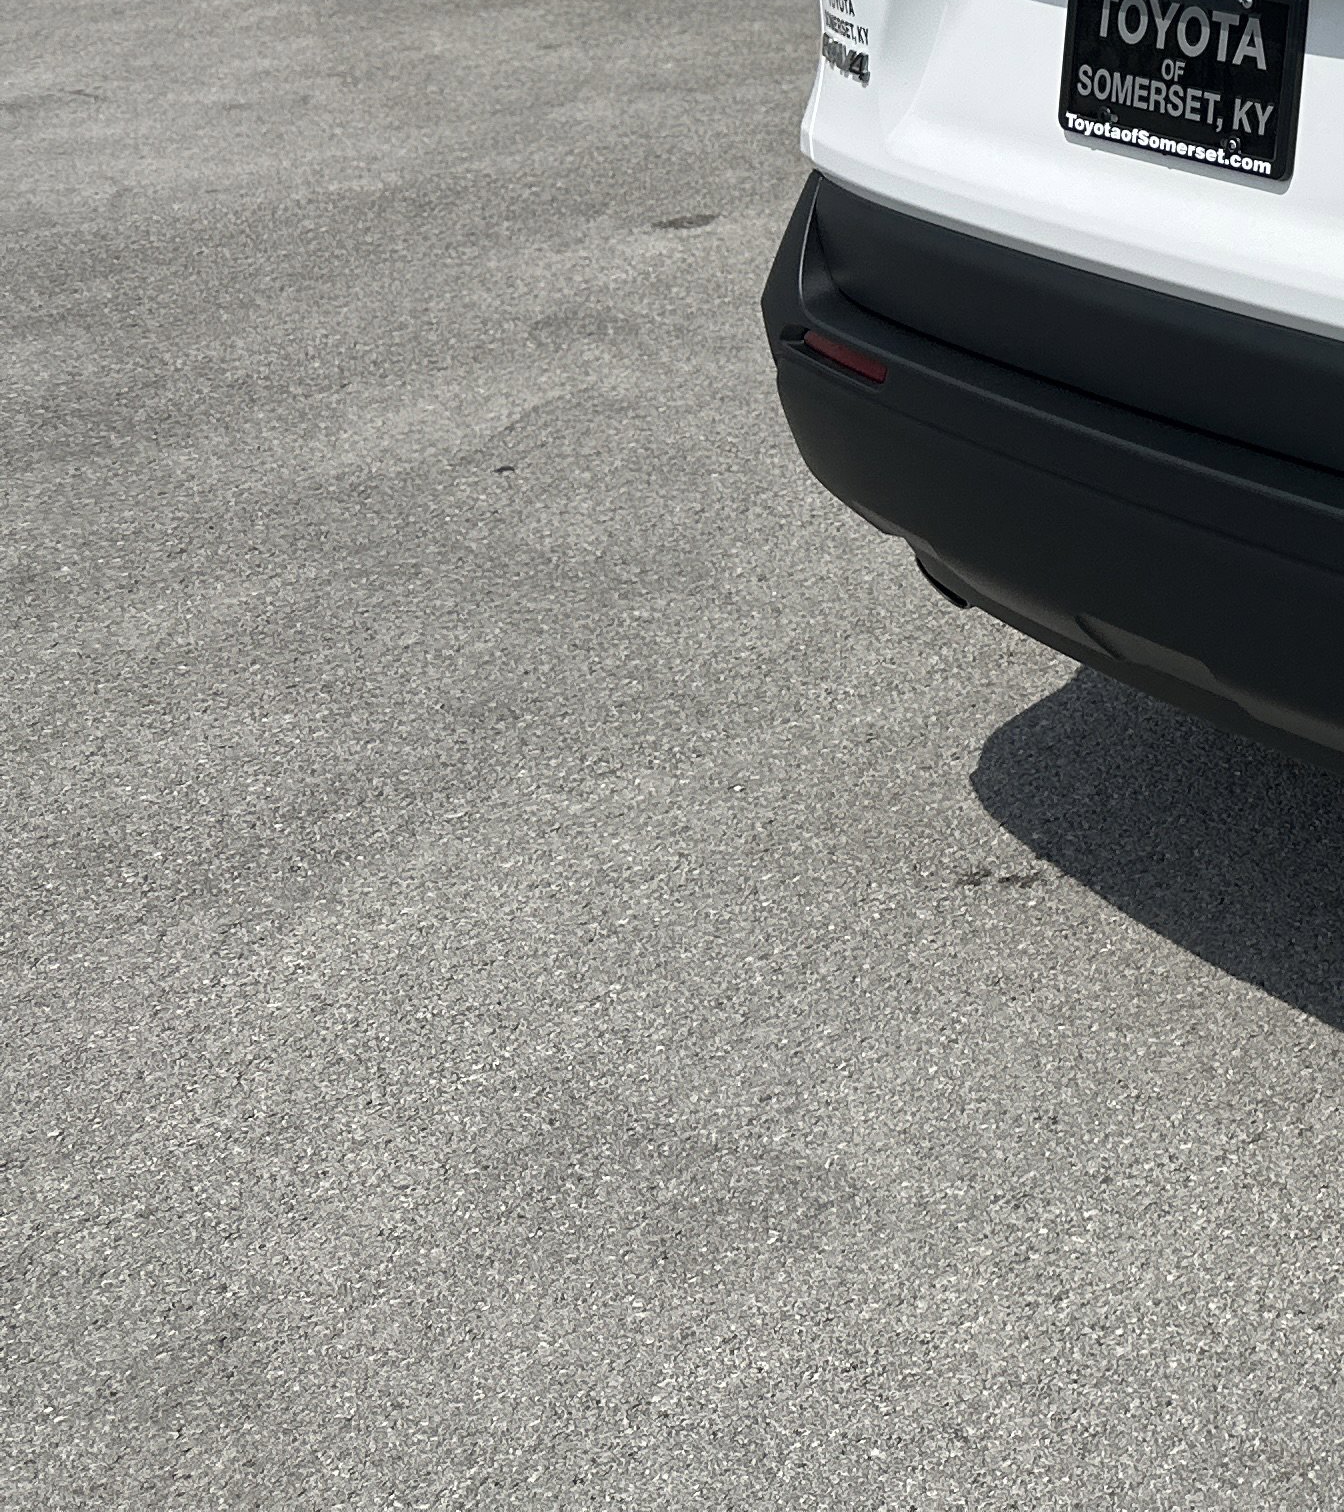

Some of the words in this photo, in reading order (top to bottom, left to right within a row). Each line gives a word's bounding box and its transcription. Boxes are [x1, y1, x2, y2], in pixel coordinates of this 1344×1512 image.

[857, 25, 869, 45] KY
[1161, 58, 1186, 82] OF
[1077, 64, 1222, 133] SOMERSET,
[1232, 97, 1274, 136] KY
[1065, 111, 1272, 175] ToyotaofSomerset.com
